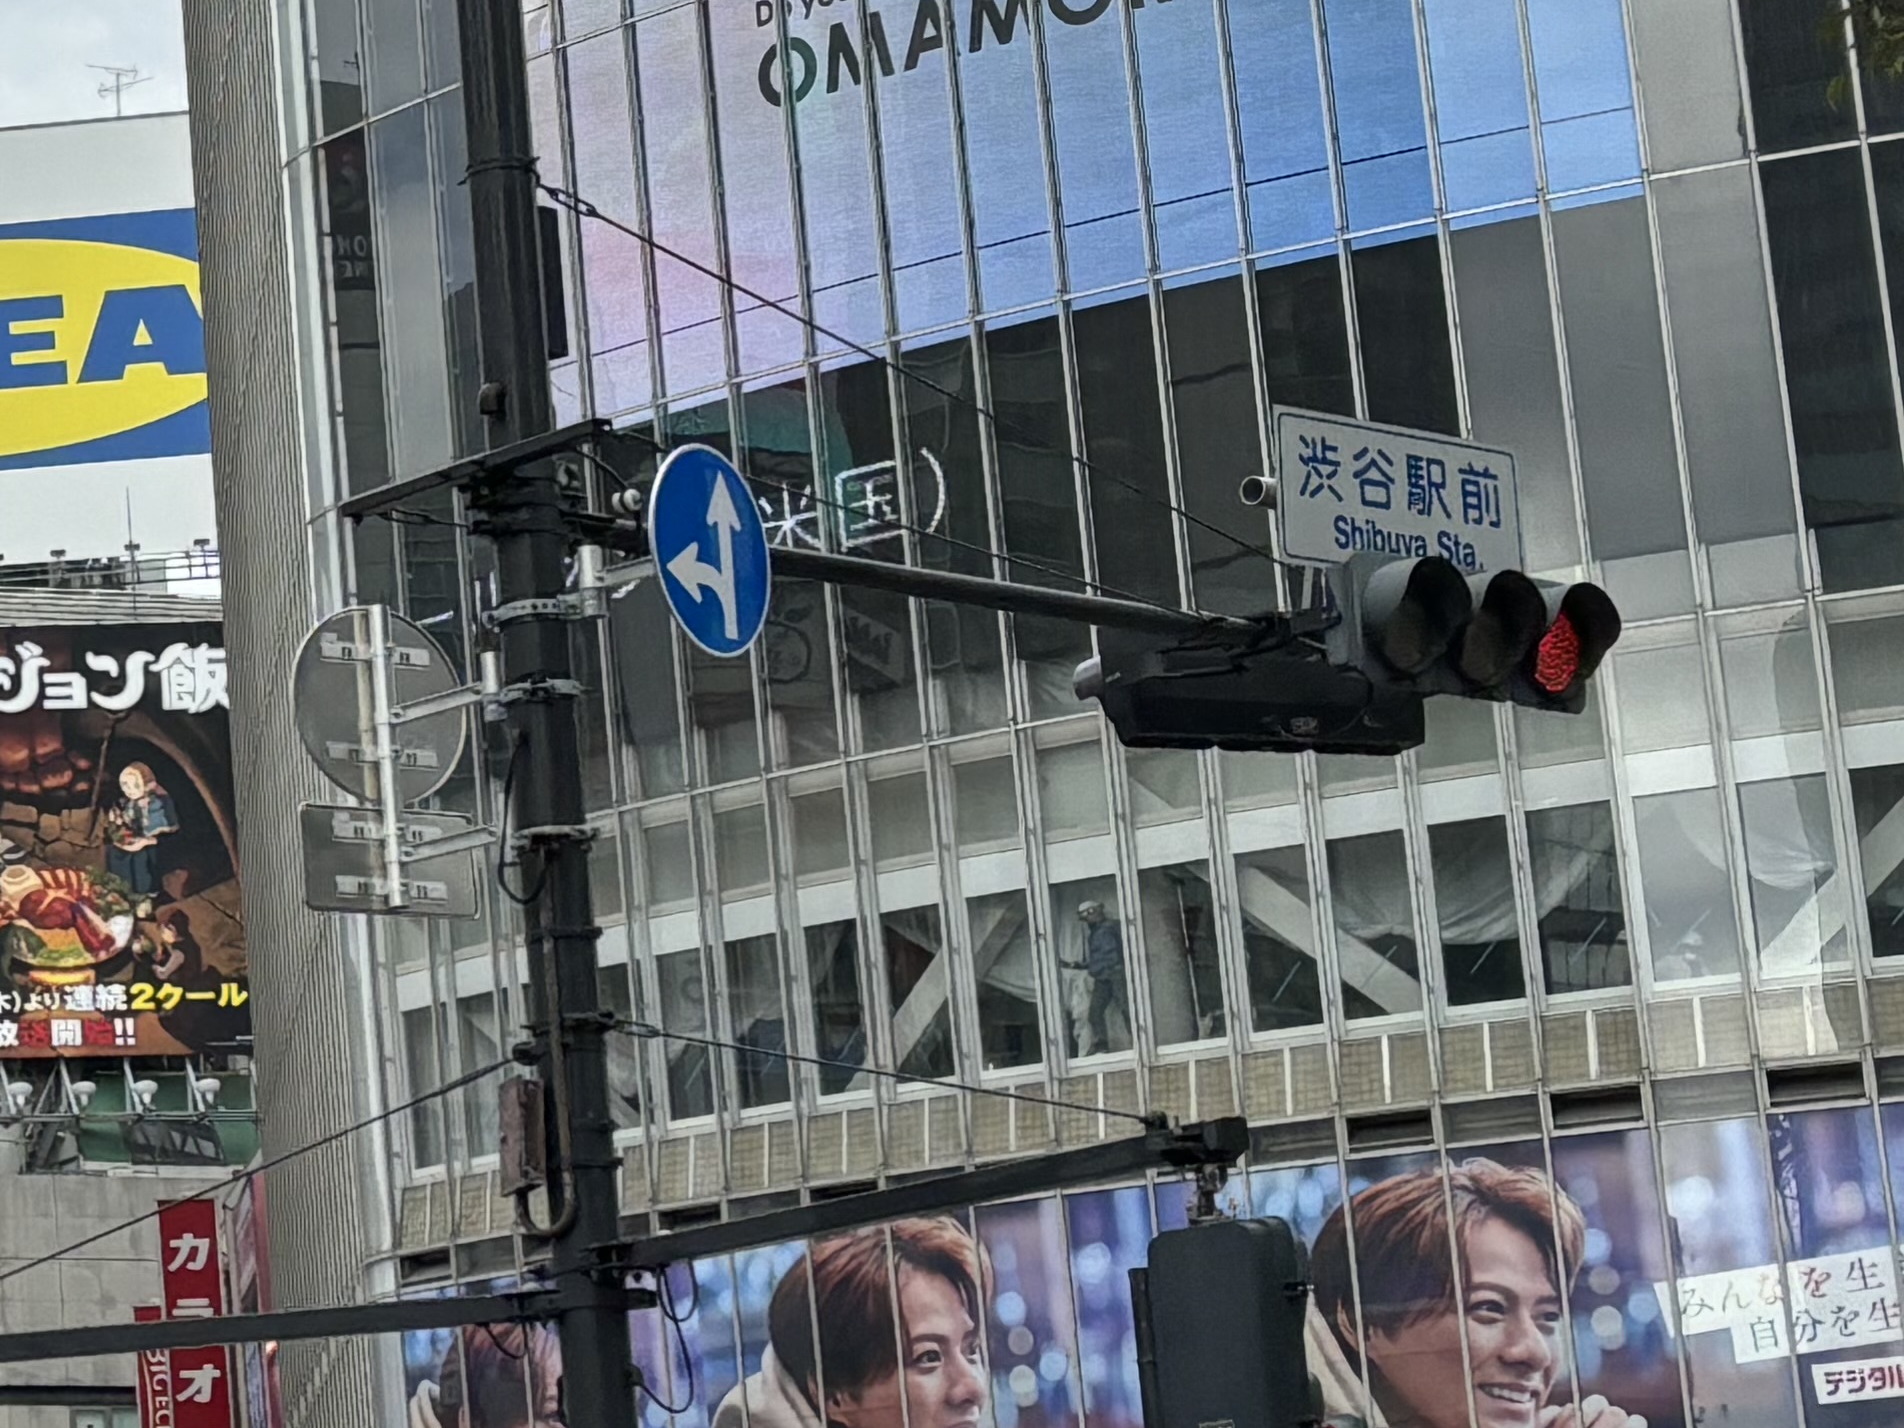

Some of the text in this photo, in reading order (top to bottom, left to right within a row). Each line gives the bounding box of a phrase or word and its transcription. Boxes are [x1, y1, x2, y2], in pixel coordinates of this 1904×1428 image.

[1298, 434, 1503, 530] 渋谷駅前
[1333, 515, 1428, 560] Shibuya
[1679, 1256, 1904, 1320] みんなを生
